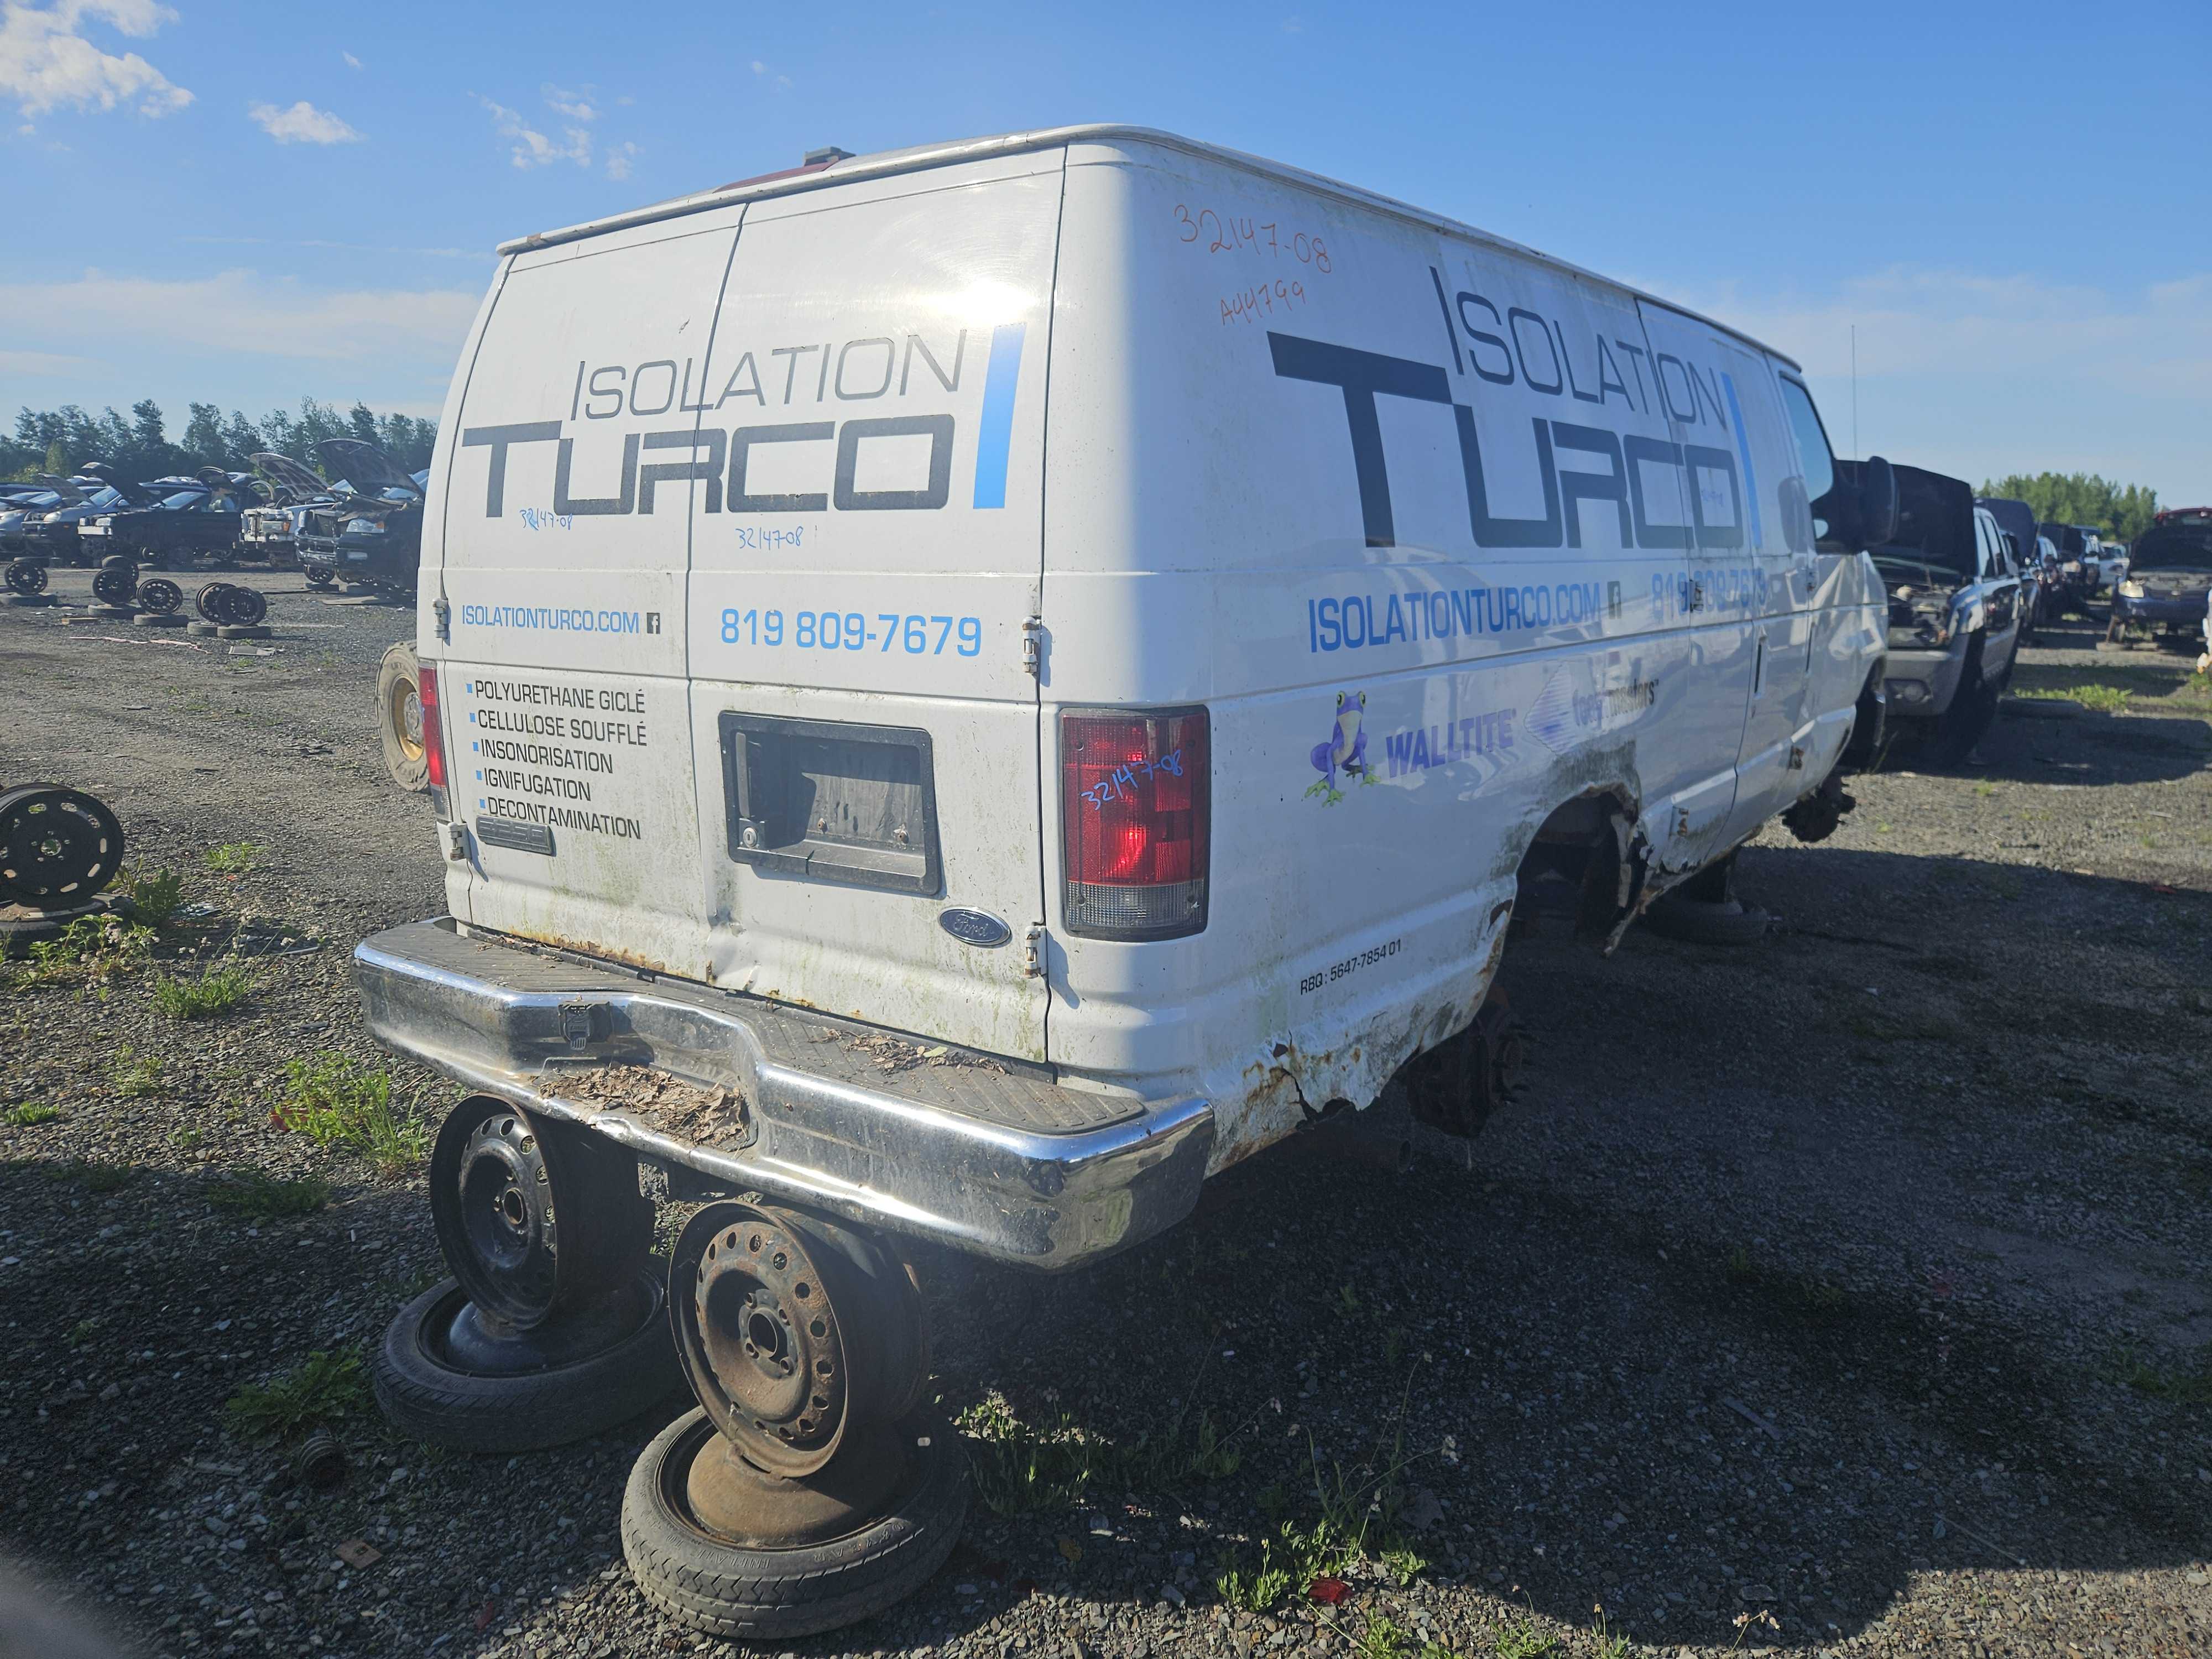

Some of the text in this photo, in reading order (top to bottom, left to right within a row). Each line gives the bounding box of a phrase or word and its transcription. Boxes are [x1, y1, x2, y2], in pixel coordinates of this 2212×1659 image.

[1175, 205, 1332, 273] 32147-08
[1429, 266, 1727, 430] ISOLATION
[570, 329, 967, 420] ISOLATION
[1266, 331, 1744, 549] TURCO
[461, 413, 955, 518] TURCO
[462, 605, 639, 633] ISOLATIONTURCO.COM
[722, 609, 981, 656] 819 809-7679
[1308, 583, 1600, 653] ISOLATIONTURCO.COM
[475, 680, 645, 713] POLYURETHANE GICLÉ
[478, 709, 647, 746] CELLULOSE SOUFFLÉ
[481, 739, 613, 773] INSONORISATION
[484, 768, 591, 801] IGNIFUGATION
[488, 797, 641, 839] DECONTAMINATION
[953, 914, 988, 937] Ford
[1331, 945, 1386, 981] 5647-7854
[1389, 939, 1401, 956] 01
